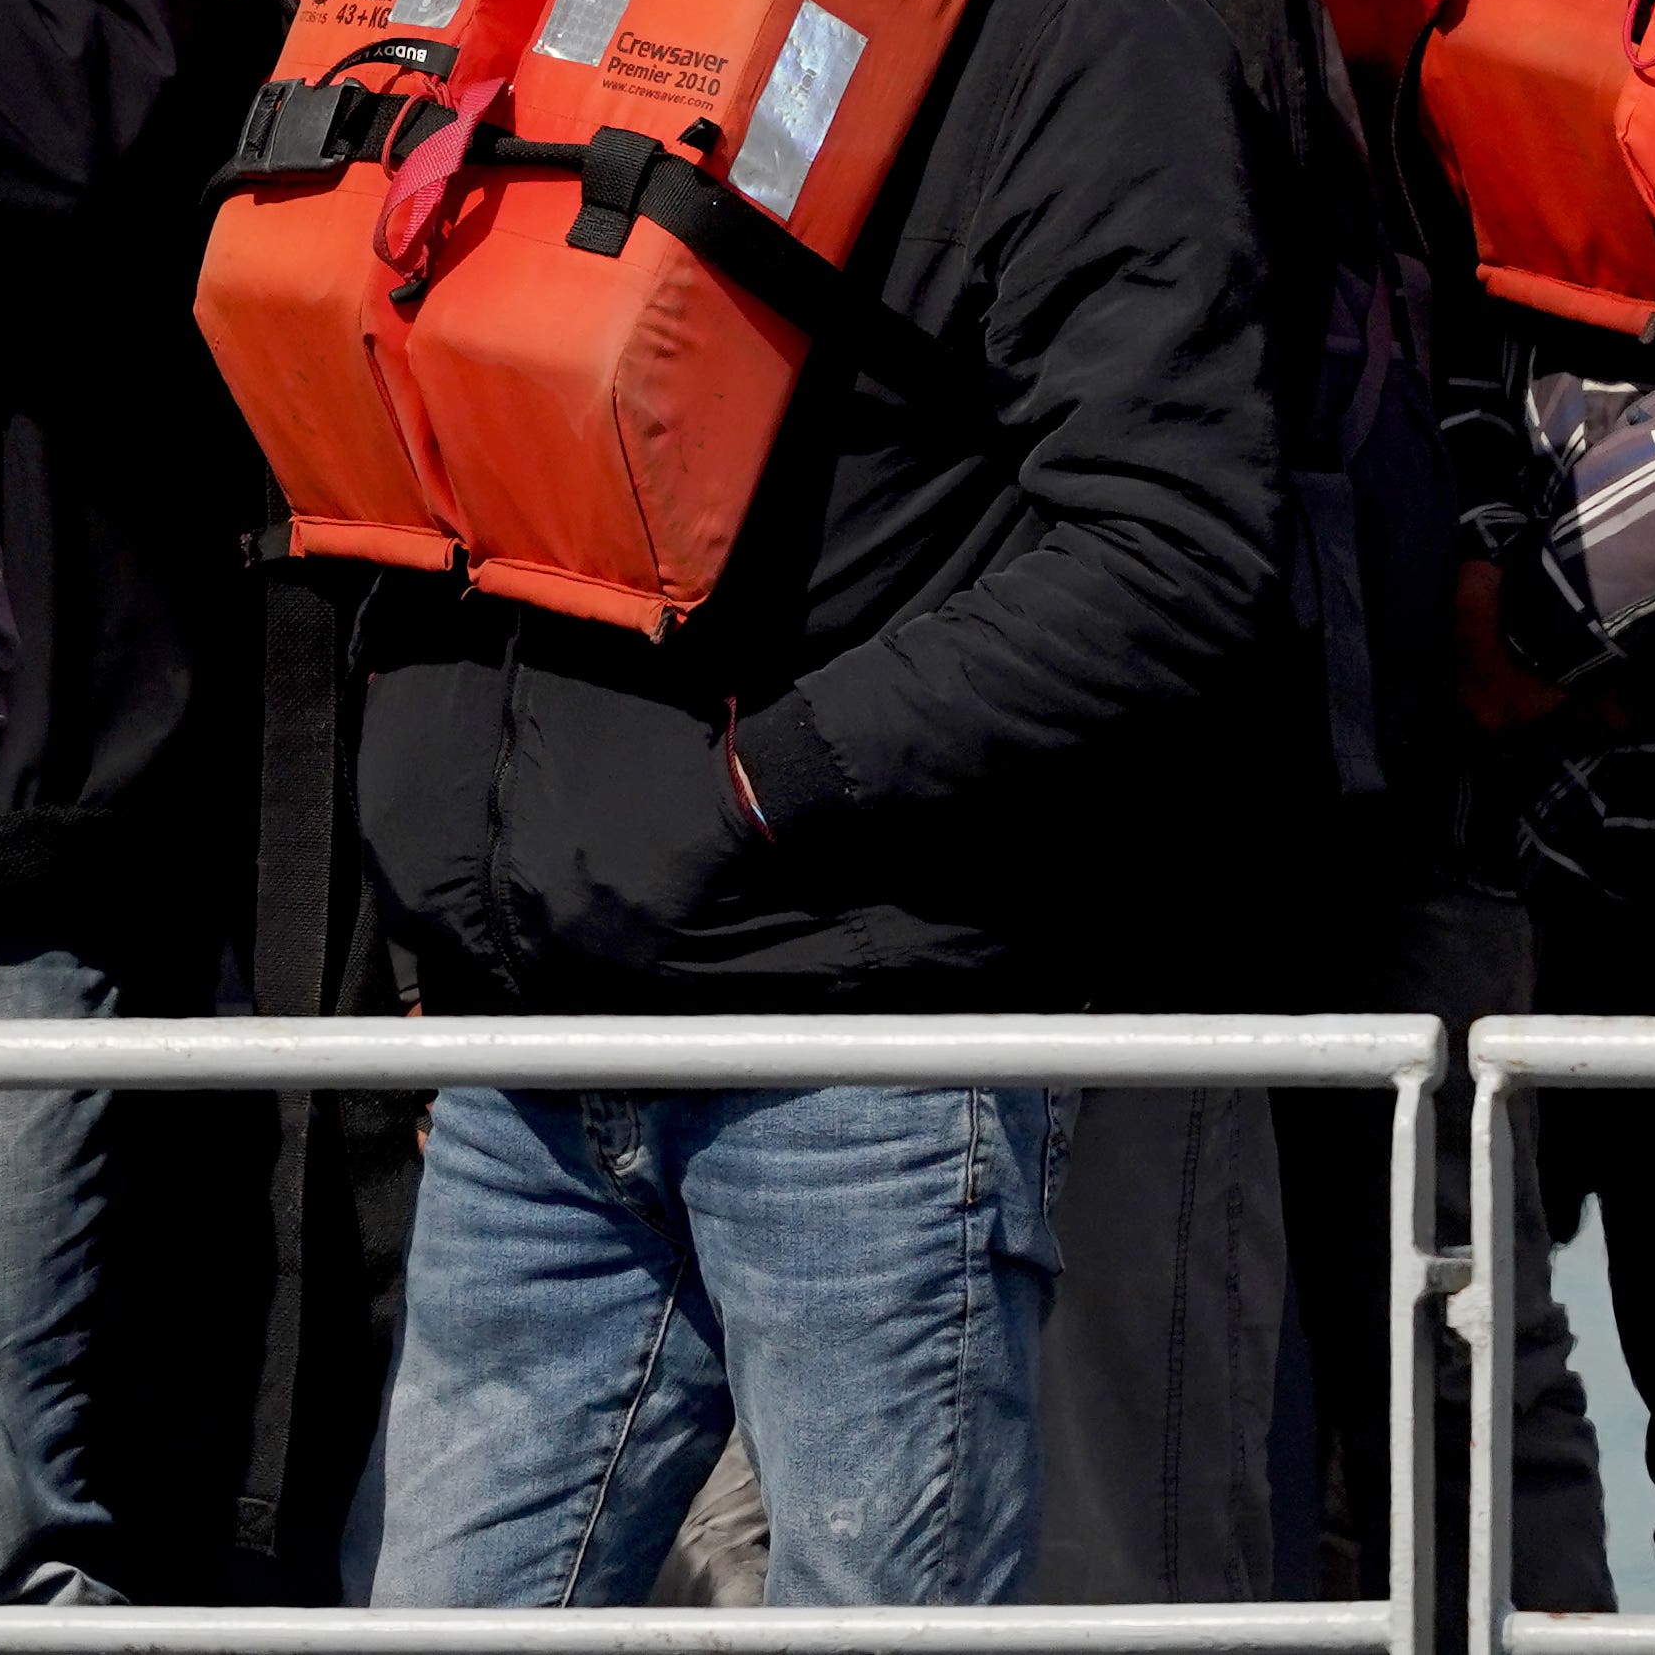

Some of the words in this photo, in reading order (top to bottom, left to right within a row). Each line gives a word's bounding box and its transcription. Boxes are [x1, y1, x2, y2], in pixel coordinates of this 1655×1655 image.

[374, 45, 428, 63] BUDDY
[616, 31, 730, 74] Crewsaver
[602, 78, 715, 112] www.crewsaver.com
[607, 56, 672, 85] Premier
[674, 71, 721, 97] 2010
